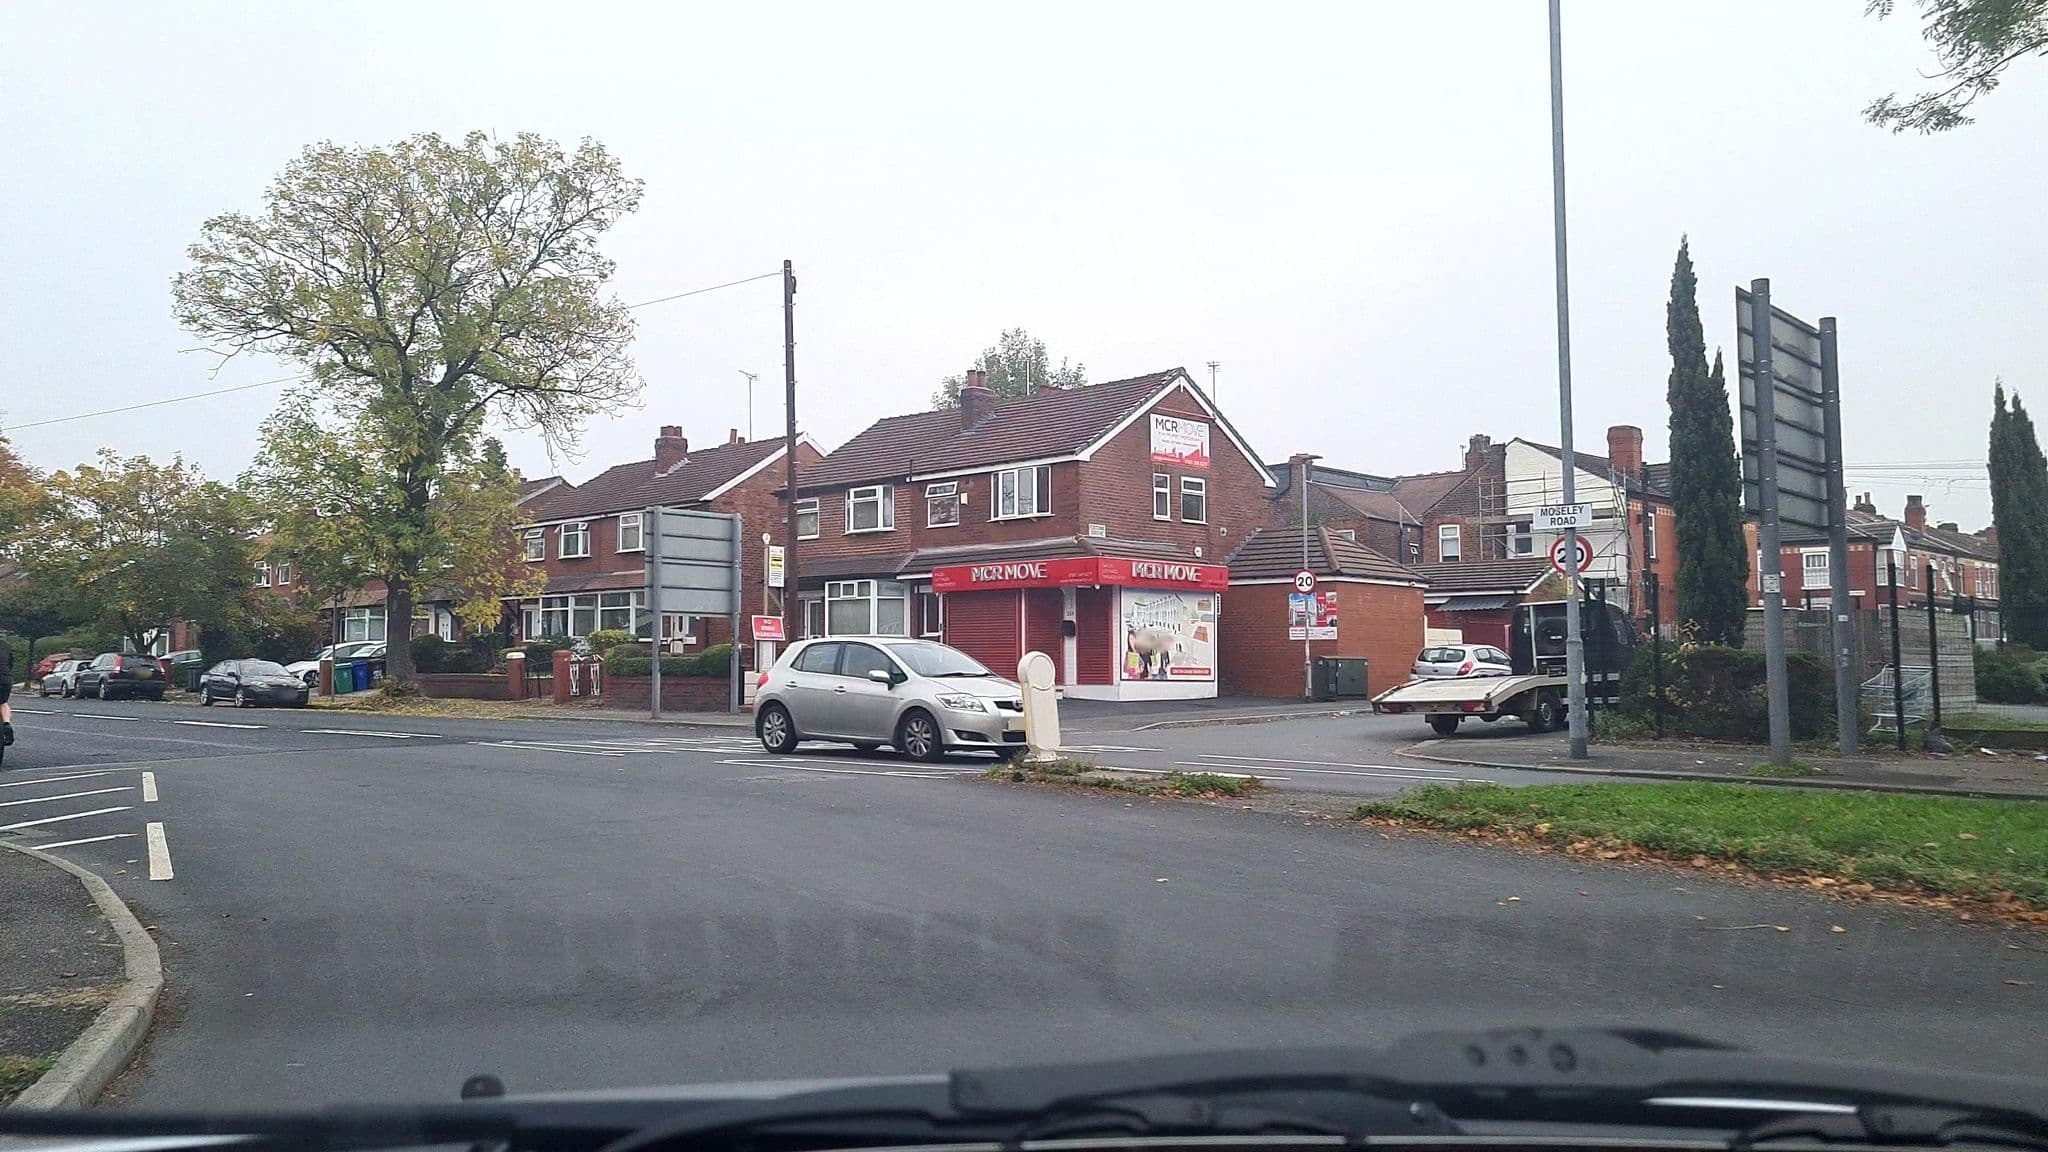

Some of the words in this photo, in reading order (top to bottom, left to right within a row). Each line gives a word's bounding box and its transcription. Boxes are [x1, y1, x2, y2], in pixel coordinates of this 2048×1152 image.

[1540, 506, 1584, 516] MOSELEY
[1550, 517, 1576, 525] ROAD
[971, 566, 1003, 582] MCR
[1004, 563, 1048, 581] MOVE
[1132, 562, 1163, 579] MCR
[1164, 564, 1202, 582] MOVE
[1297, 576, 1313, 587] 20
